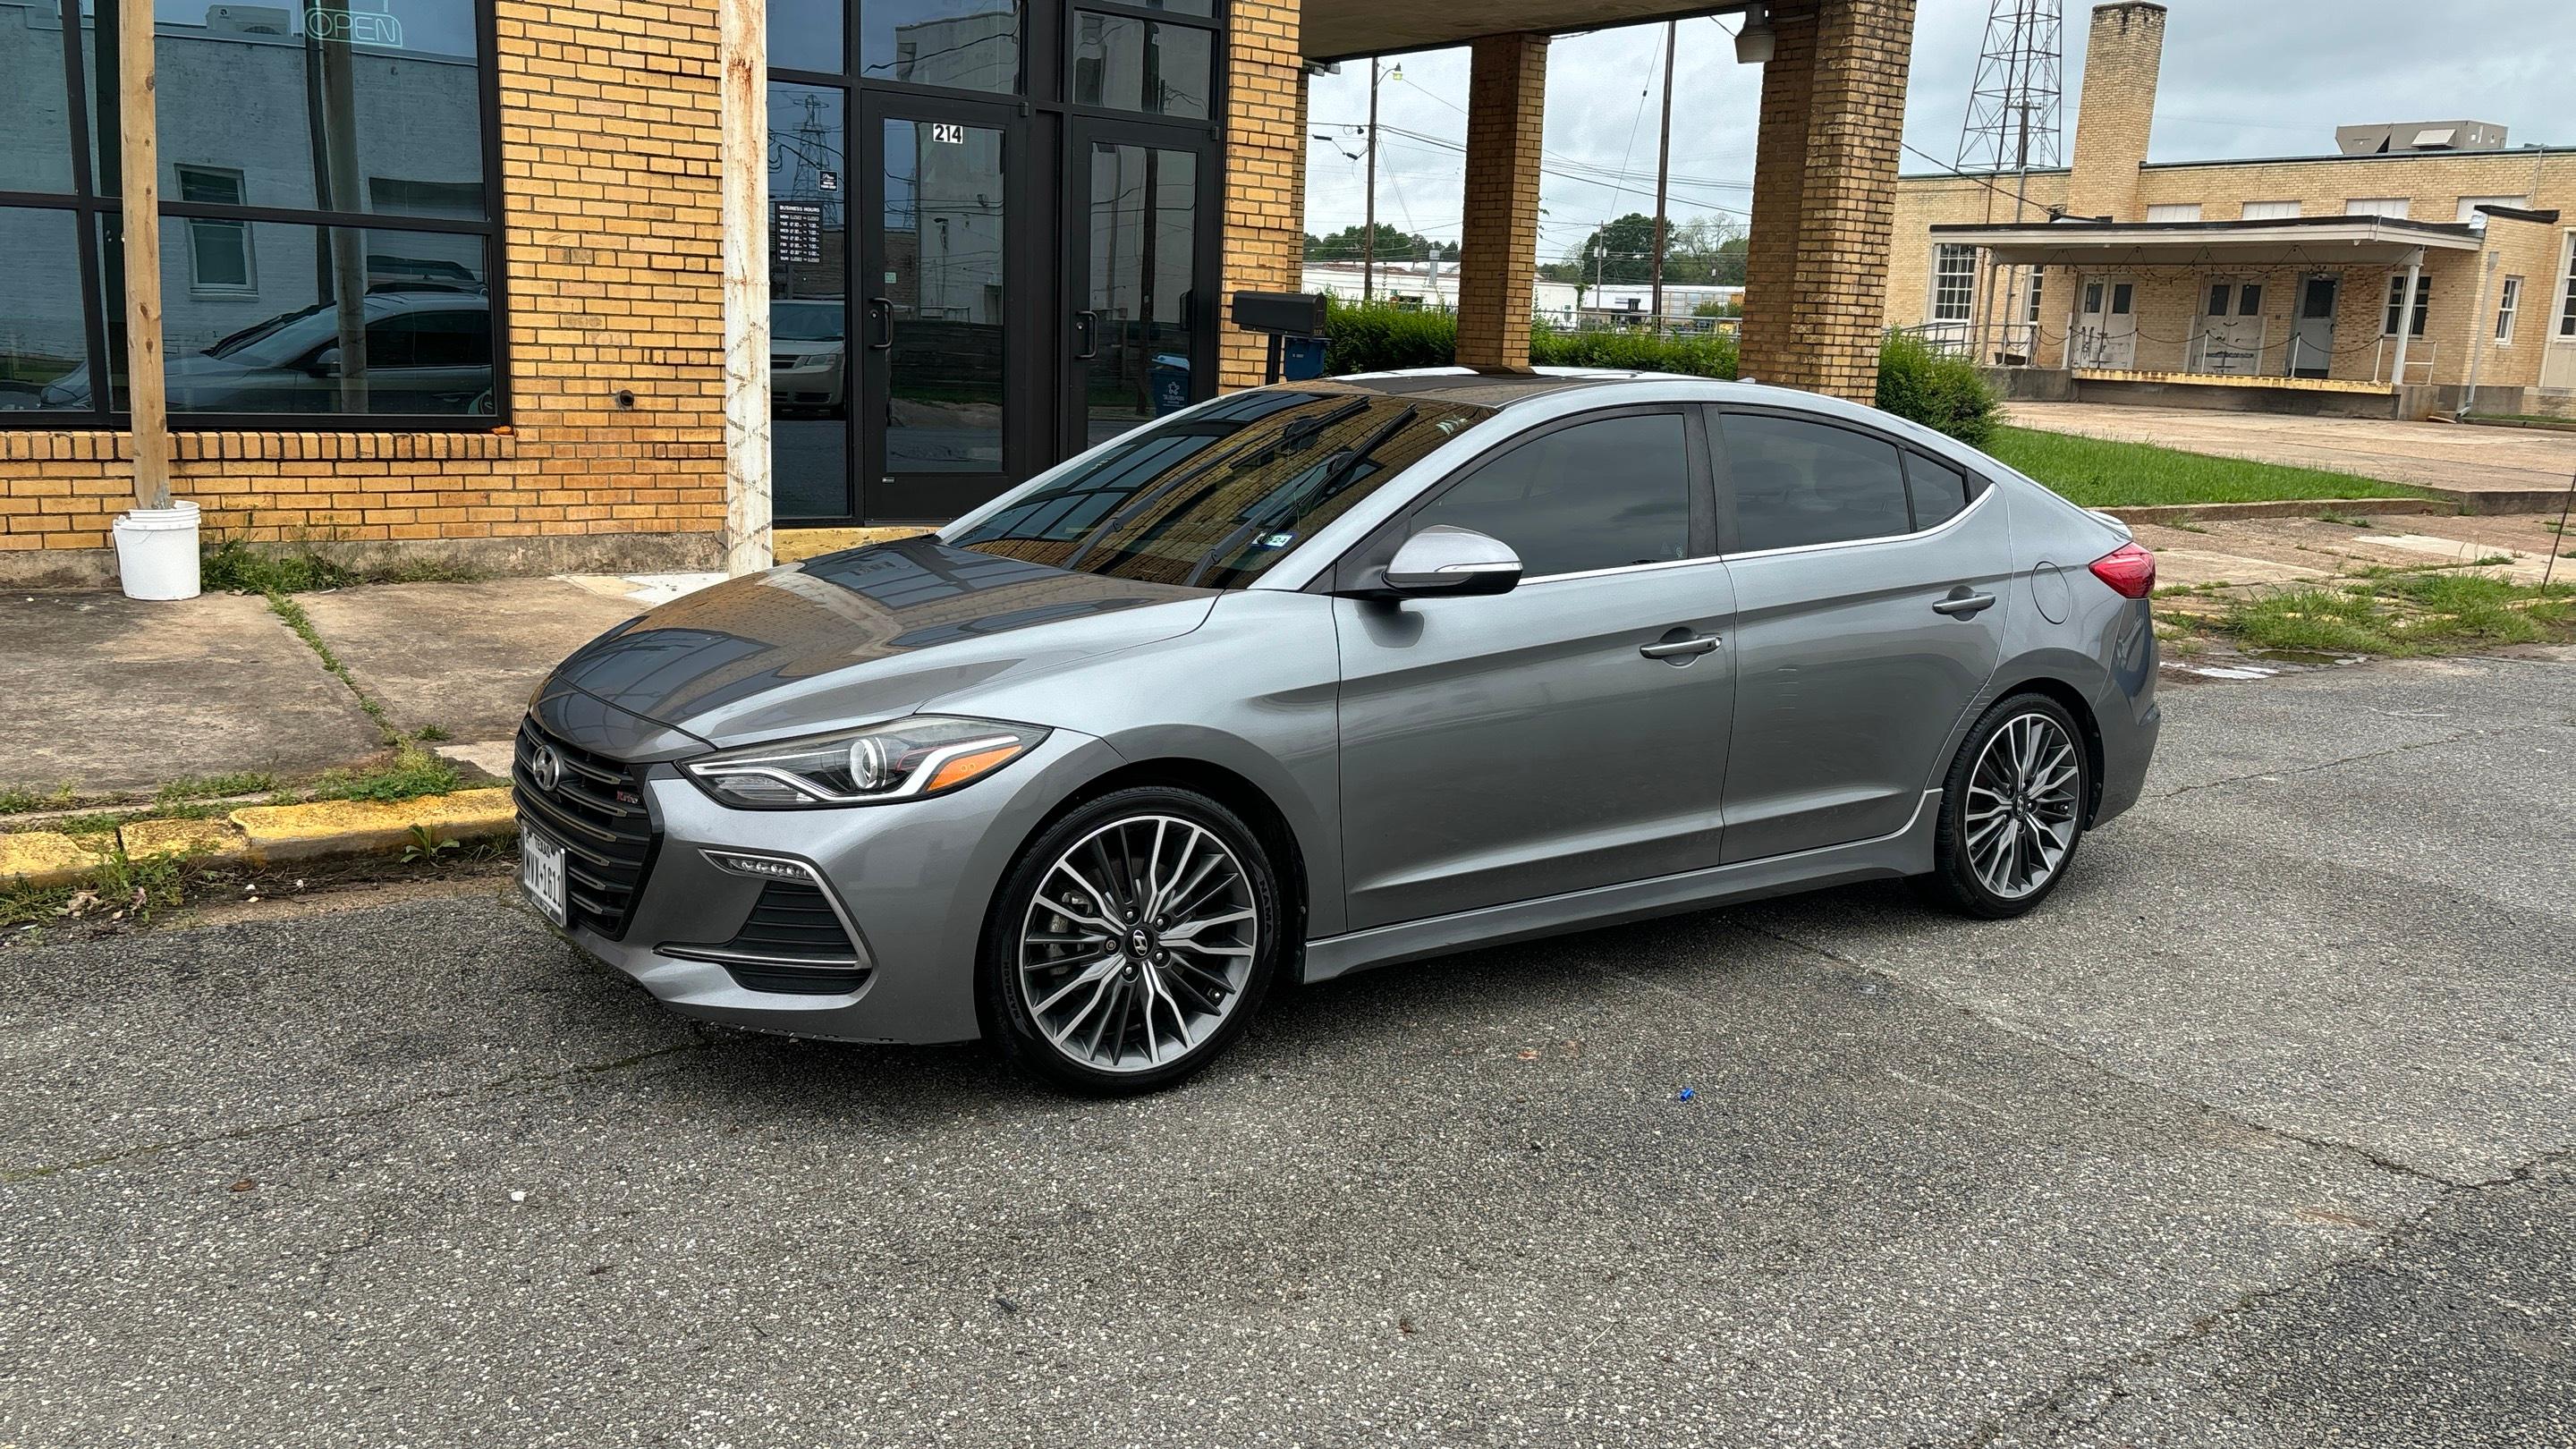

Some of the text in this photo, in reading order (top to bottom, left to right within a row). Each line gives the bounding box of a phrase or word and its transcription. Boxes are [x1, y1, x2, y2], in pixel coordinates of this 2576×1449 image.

[309, 12, 395, 42] OPEN
[934, 123, 962, 143] 214
[533, 835, 551, 860] TEXAS
